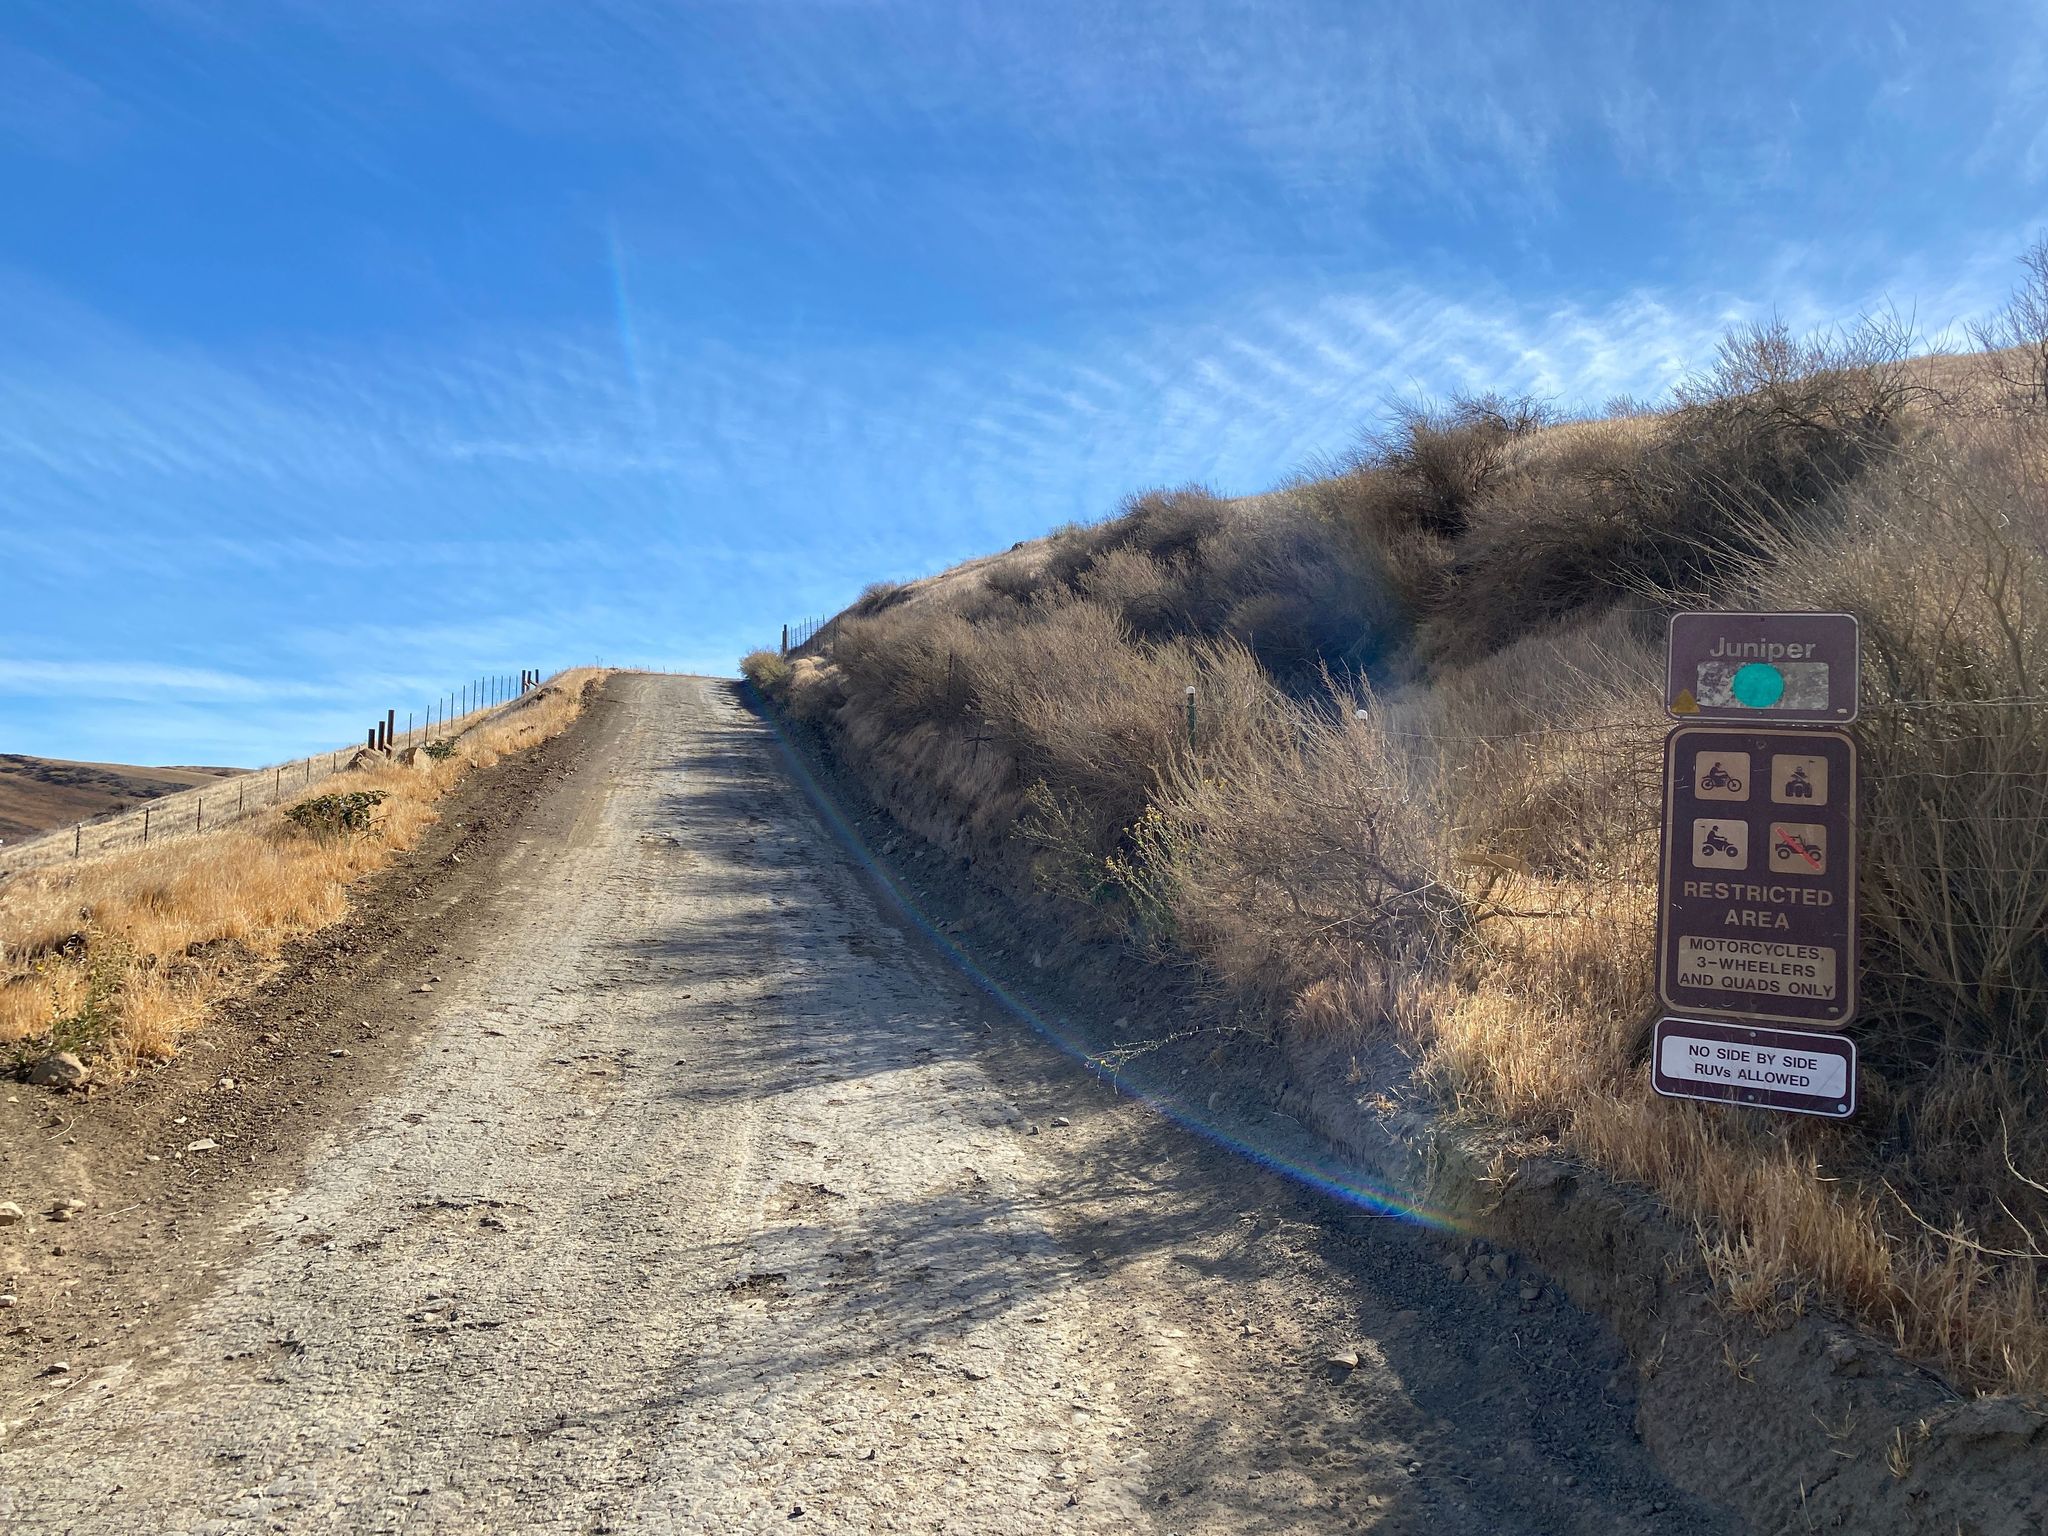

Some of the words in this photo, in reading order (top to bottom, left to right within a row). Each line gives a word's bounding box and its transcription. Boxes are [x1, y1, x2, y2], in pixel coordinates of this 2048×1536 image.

[1709, 636, 1816, 662] Juniper
[1683, 880, 1833, 906] RESTRICTED
[1724, 909, 1790, 930] AREA
[1689, 938, 1825, 961] MOTORCYCLES,
[1697, 956, 1816, 978] 3-WHEELERS
[1679, 973, 1714, 986] AND
[1721, 976, 1781, 993] QUADS
[1788, 982, 1833, 997] ONLY
[1688, 1044, 1710, 1057] NO
[1716, 1048, 1750, 1063] SIDE
[1756, 1053, 1776, 1065] BY
[1782, 1056, 1818, 1070] SIDE
[1694, 1063, 1731, 1078] RUVs
[1737, 1068, 1810, 1087] ALLOWED
